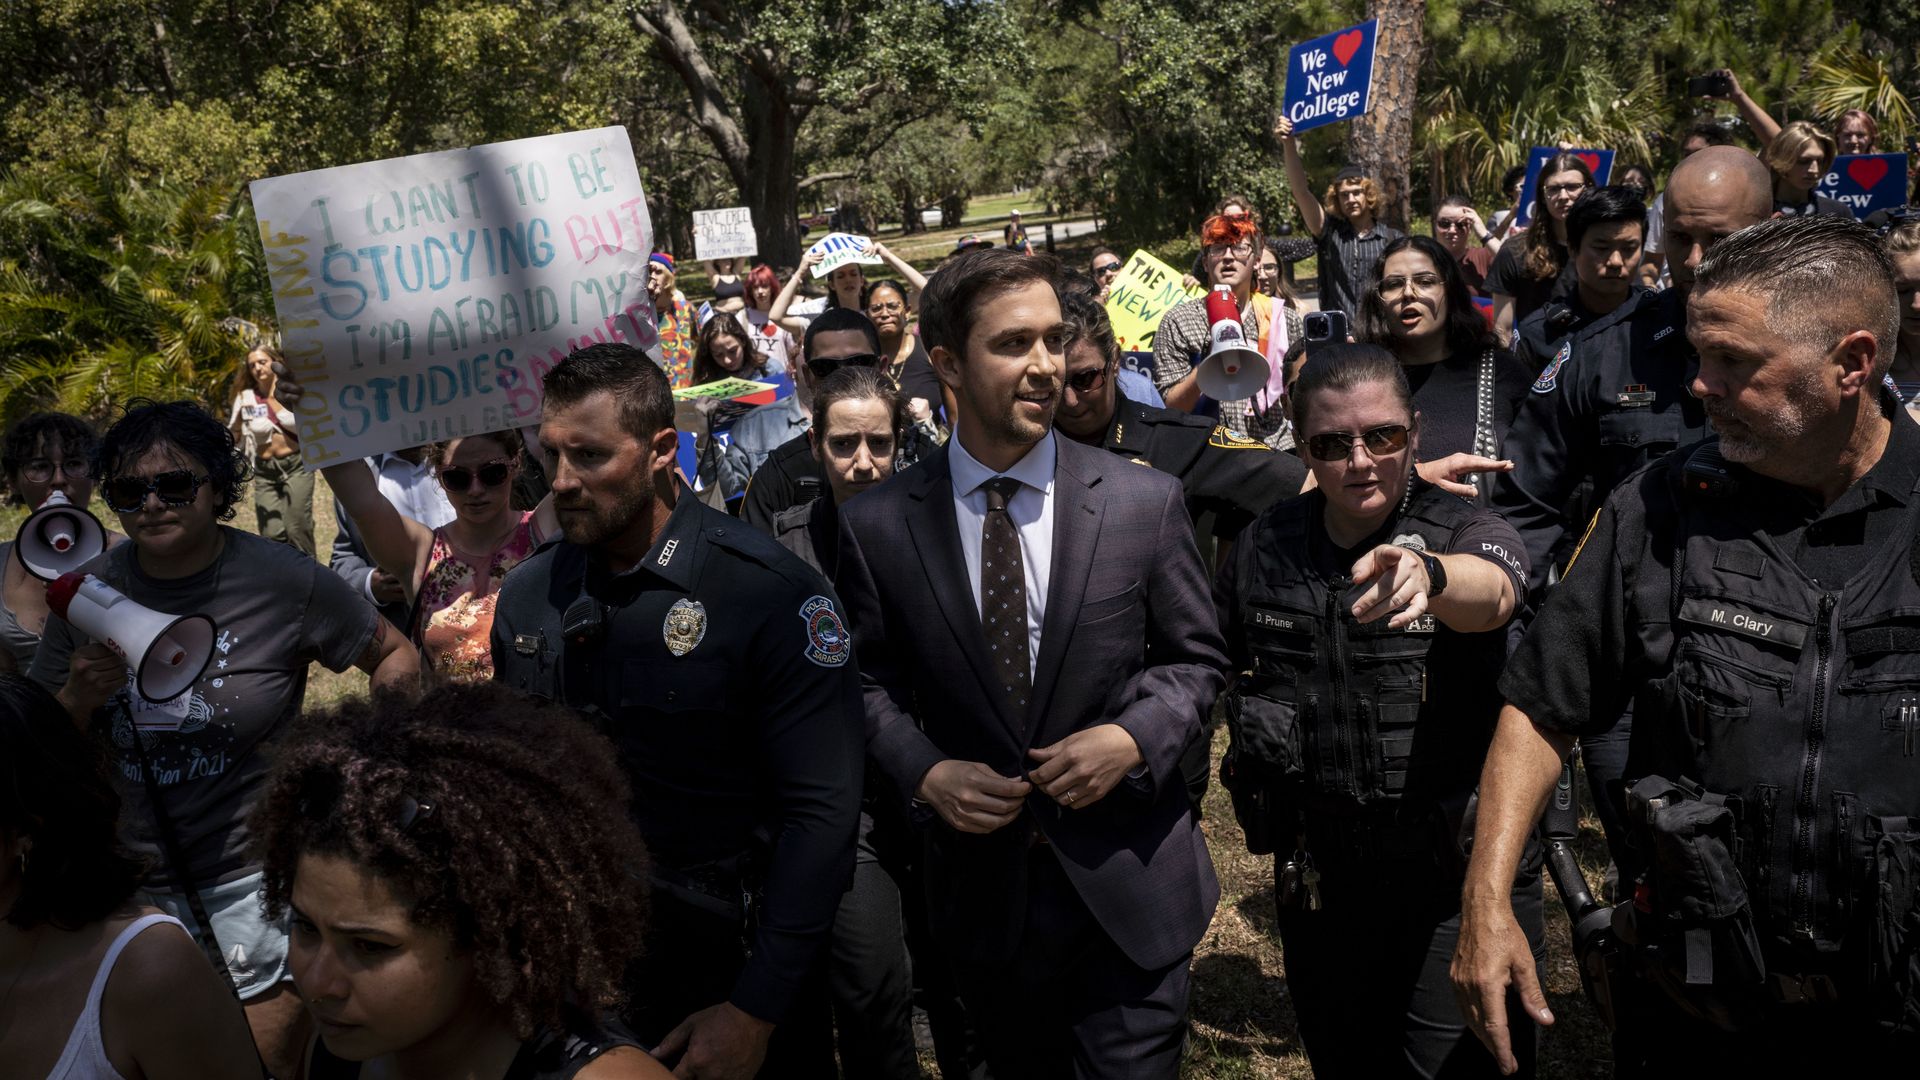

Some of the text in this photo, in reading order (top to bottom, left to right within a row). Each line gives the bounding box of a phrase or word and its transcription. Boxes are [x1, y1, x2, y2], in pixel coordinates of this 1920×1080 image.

[1300, 48, 1327, 73] We
[1305, 70, 1348, 96] New
[1290, 91, 1360, 123] College
[1816, 171, 1840, 187] e
[311, 147, 614, 252] I WANT TO BE
[318, 197, 645, 321] STUDYING BUT
[1130, 257, 1166, 290] THE
[1108, 284, 1161, 321] NEW
[345, 272, 627, 370] I'M AFRAID MY
[260, 219, 342, 467] PROTECT NCF
[338, 348, 519, 437] STUDIES
[805, 599, 829, 615] POLICE
[1256, 612, 1294, 629] D. Pruner
[1711, 608, 1773, 636] M. Clary
[187, 750, 225, 781] 2021
